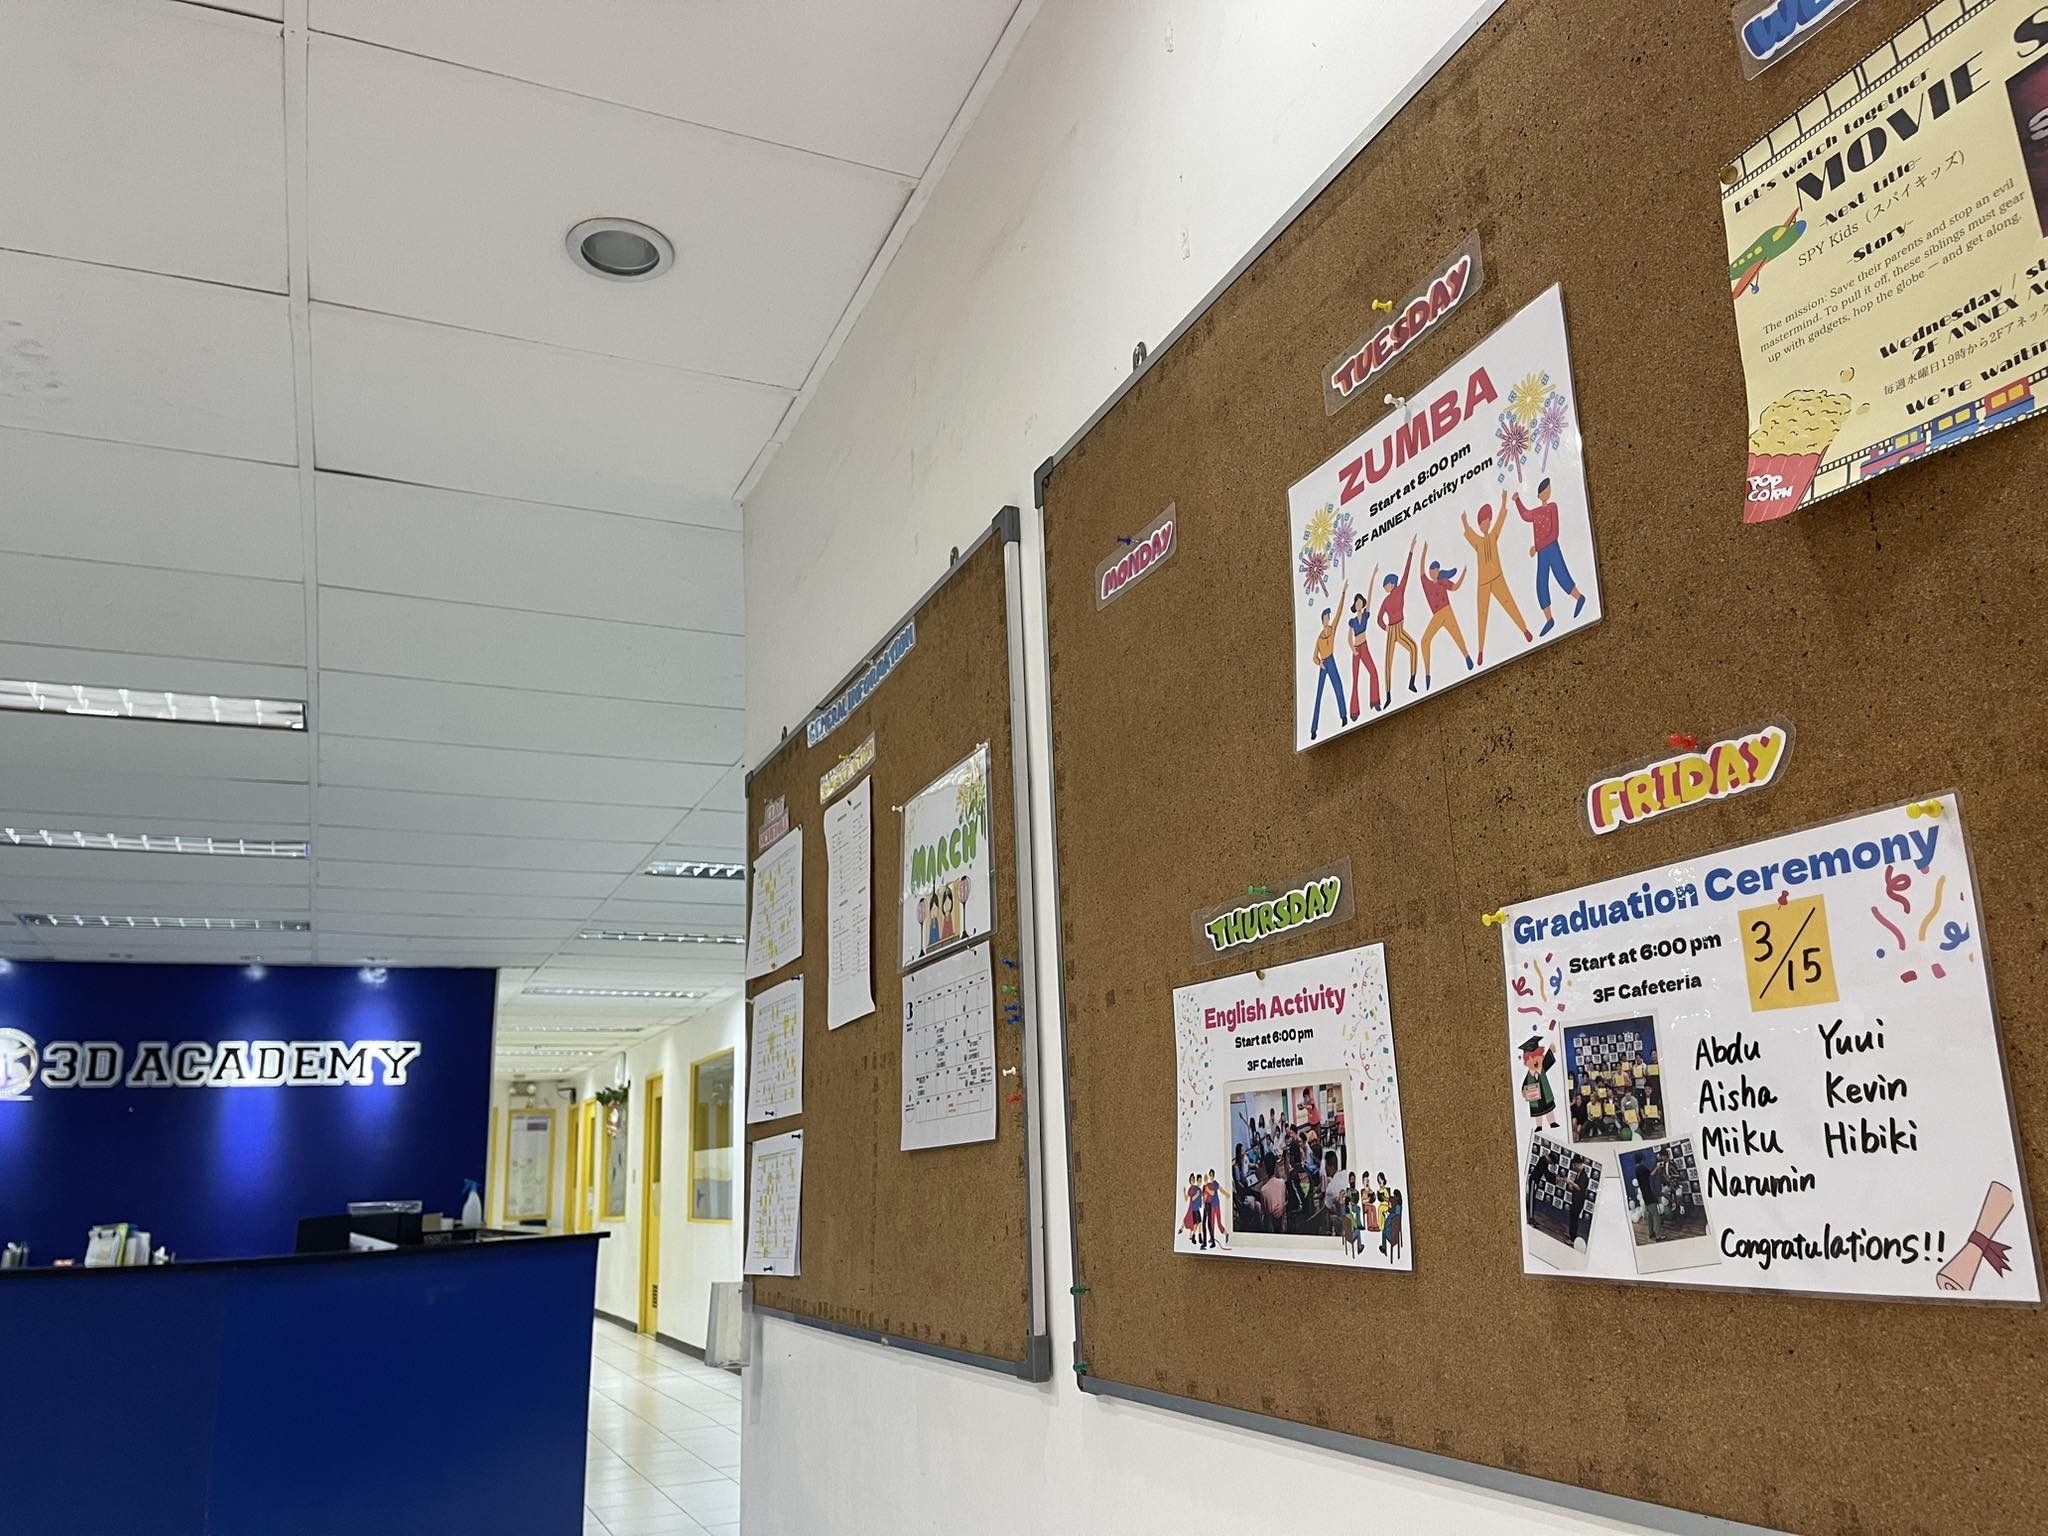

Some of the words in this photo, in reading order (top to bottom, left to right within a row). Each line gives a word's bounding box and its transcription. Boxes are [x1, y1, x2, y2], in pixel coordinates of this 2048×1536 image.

[1735, 178, 1777, 213] Let's
[1782, 135, 1838, 179] watch
[1844, 68, 1930, 135] together
[1796, 51, 1991, 211] MOVIE
[1762, 319, 1783, 335] The
[1785, 295, 1827, 323] mission:
[1830, 280, 1855, 298] Save
[1857, 263, 1882, 282] their
[1884, 236, 1923, 268] parents
[1926, 220, 1946, 240] and
[1949, 205, 1973, 225] stop
[1975, 195, 1990, 209] an
[1993, 178, 2014, 198] evil
[1798, 240, 1825, 266] SPY
[1829, 223, 1859, 248] Kids
[1760, 312, 1823, 352] mastermind.
[1824, 305, 1839, 317] To
[1841, 289, 1861, 310] pull
[1864, 284, 1872, 295] it
[1874, 273, 1891, 289] off,
[1892, 255, 1921, 278] these
[1924, 228, 1965, 259] siblings
[1967, 209, 1996, 232] must
[1999, 192, 2025, 215] gear
[1768, 350, 1781, 364] up
[1783, 337, 1806, 354] with
[1853, 300, 1874, 318] hop
[1876, 288, 1894, 304] the
[1896, 269, 1925, 295] globe
[1942, 245, 1963, 264] and
[1965, 233, 1984, 252] get
[1986, 212, 2022, 238] along.
[1333, 257, 1469, 395] TUESDAY
[1880, 285, 2003, 359] Wednesday
[1911, 337, 1939, 362] 2F
[1948, 295, 2020, 344] ANNEX
[1906, 379, 1972, 415] We're
[1338, 366, 1499, 505] ZUMBA
[1354, 534, 1369, 551] 2F
[1371, 507, 1411, 542] ANNEX
[1412, 476, 1459, 515] Activity
[1460, 457, 1493, 485] room
[1369, 487, 1401, 517] Start
[1403, 479, 1416, 495] at
[1417, 456, 1449, 486] 8:00
[1450, 444, 1471, 468] pm
[1746, 473, 1783, 491] POP
[1748, 485, 1794, 502] CORN
[1103, 522, 1172, 599] MONDAY
[808, 695, 848, 743] GENERAL
[1591, 733, 1783, 829] FRIDAY
[911, 820, 977, 894] MARCH
[1513, 882, 1699, 945] Graduation
[1704, 824, 1940, 896] Ceremony
[1207, 878, 1340, 949] THURSDAY
[1569, 947, 1617, 975] Start
[1619, 947, 1638, 966] at
[1641, 937, 1687, 962] 6:00
[1690, 931, 1722, 957] pm
[1204, 998, 1267, 1032] English
[1270, 984, 1346, 1015] Activity
[1592, 987, 1616, 1005] 3F
[1618, 972, 1702, 1001] Cafeteria
[1235, 1035, 1260, 1049] Start
[1261, 1033, 1271, 1044] at
[1272, 1029, 1296, 1043] 6:00
[1298, 1028, 1314, 1043] pm
[1247, 1060, 1259, 1071] 3F
[1260, 1054, 1304, 1070] Cafeteria
[1695, 1031, 1761, 1070] Abdu
[41, 1040, 124, 1088] 3D
[126, 1040, 422, 1088] ACADEMY
[1699, 1074, 1778, 1113] Aisha
[1826, 1071, 1907, 1108] Kevin
[1702, 1120, 1784, 1160] Miiku
[1824, 1117, 1918, 1158] Hibiki
[1707, 1166, 1816, 1198] Narumin
[1720, 1223, 1945, 1270] Congratulations!!
